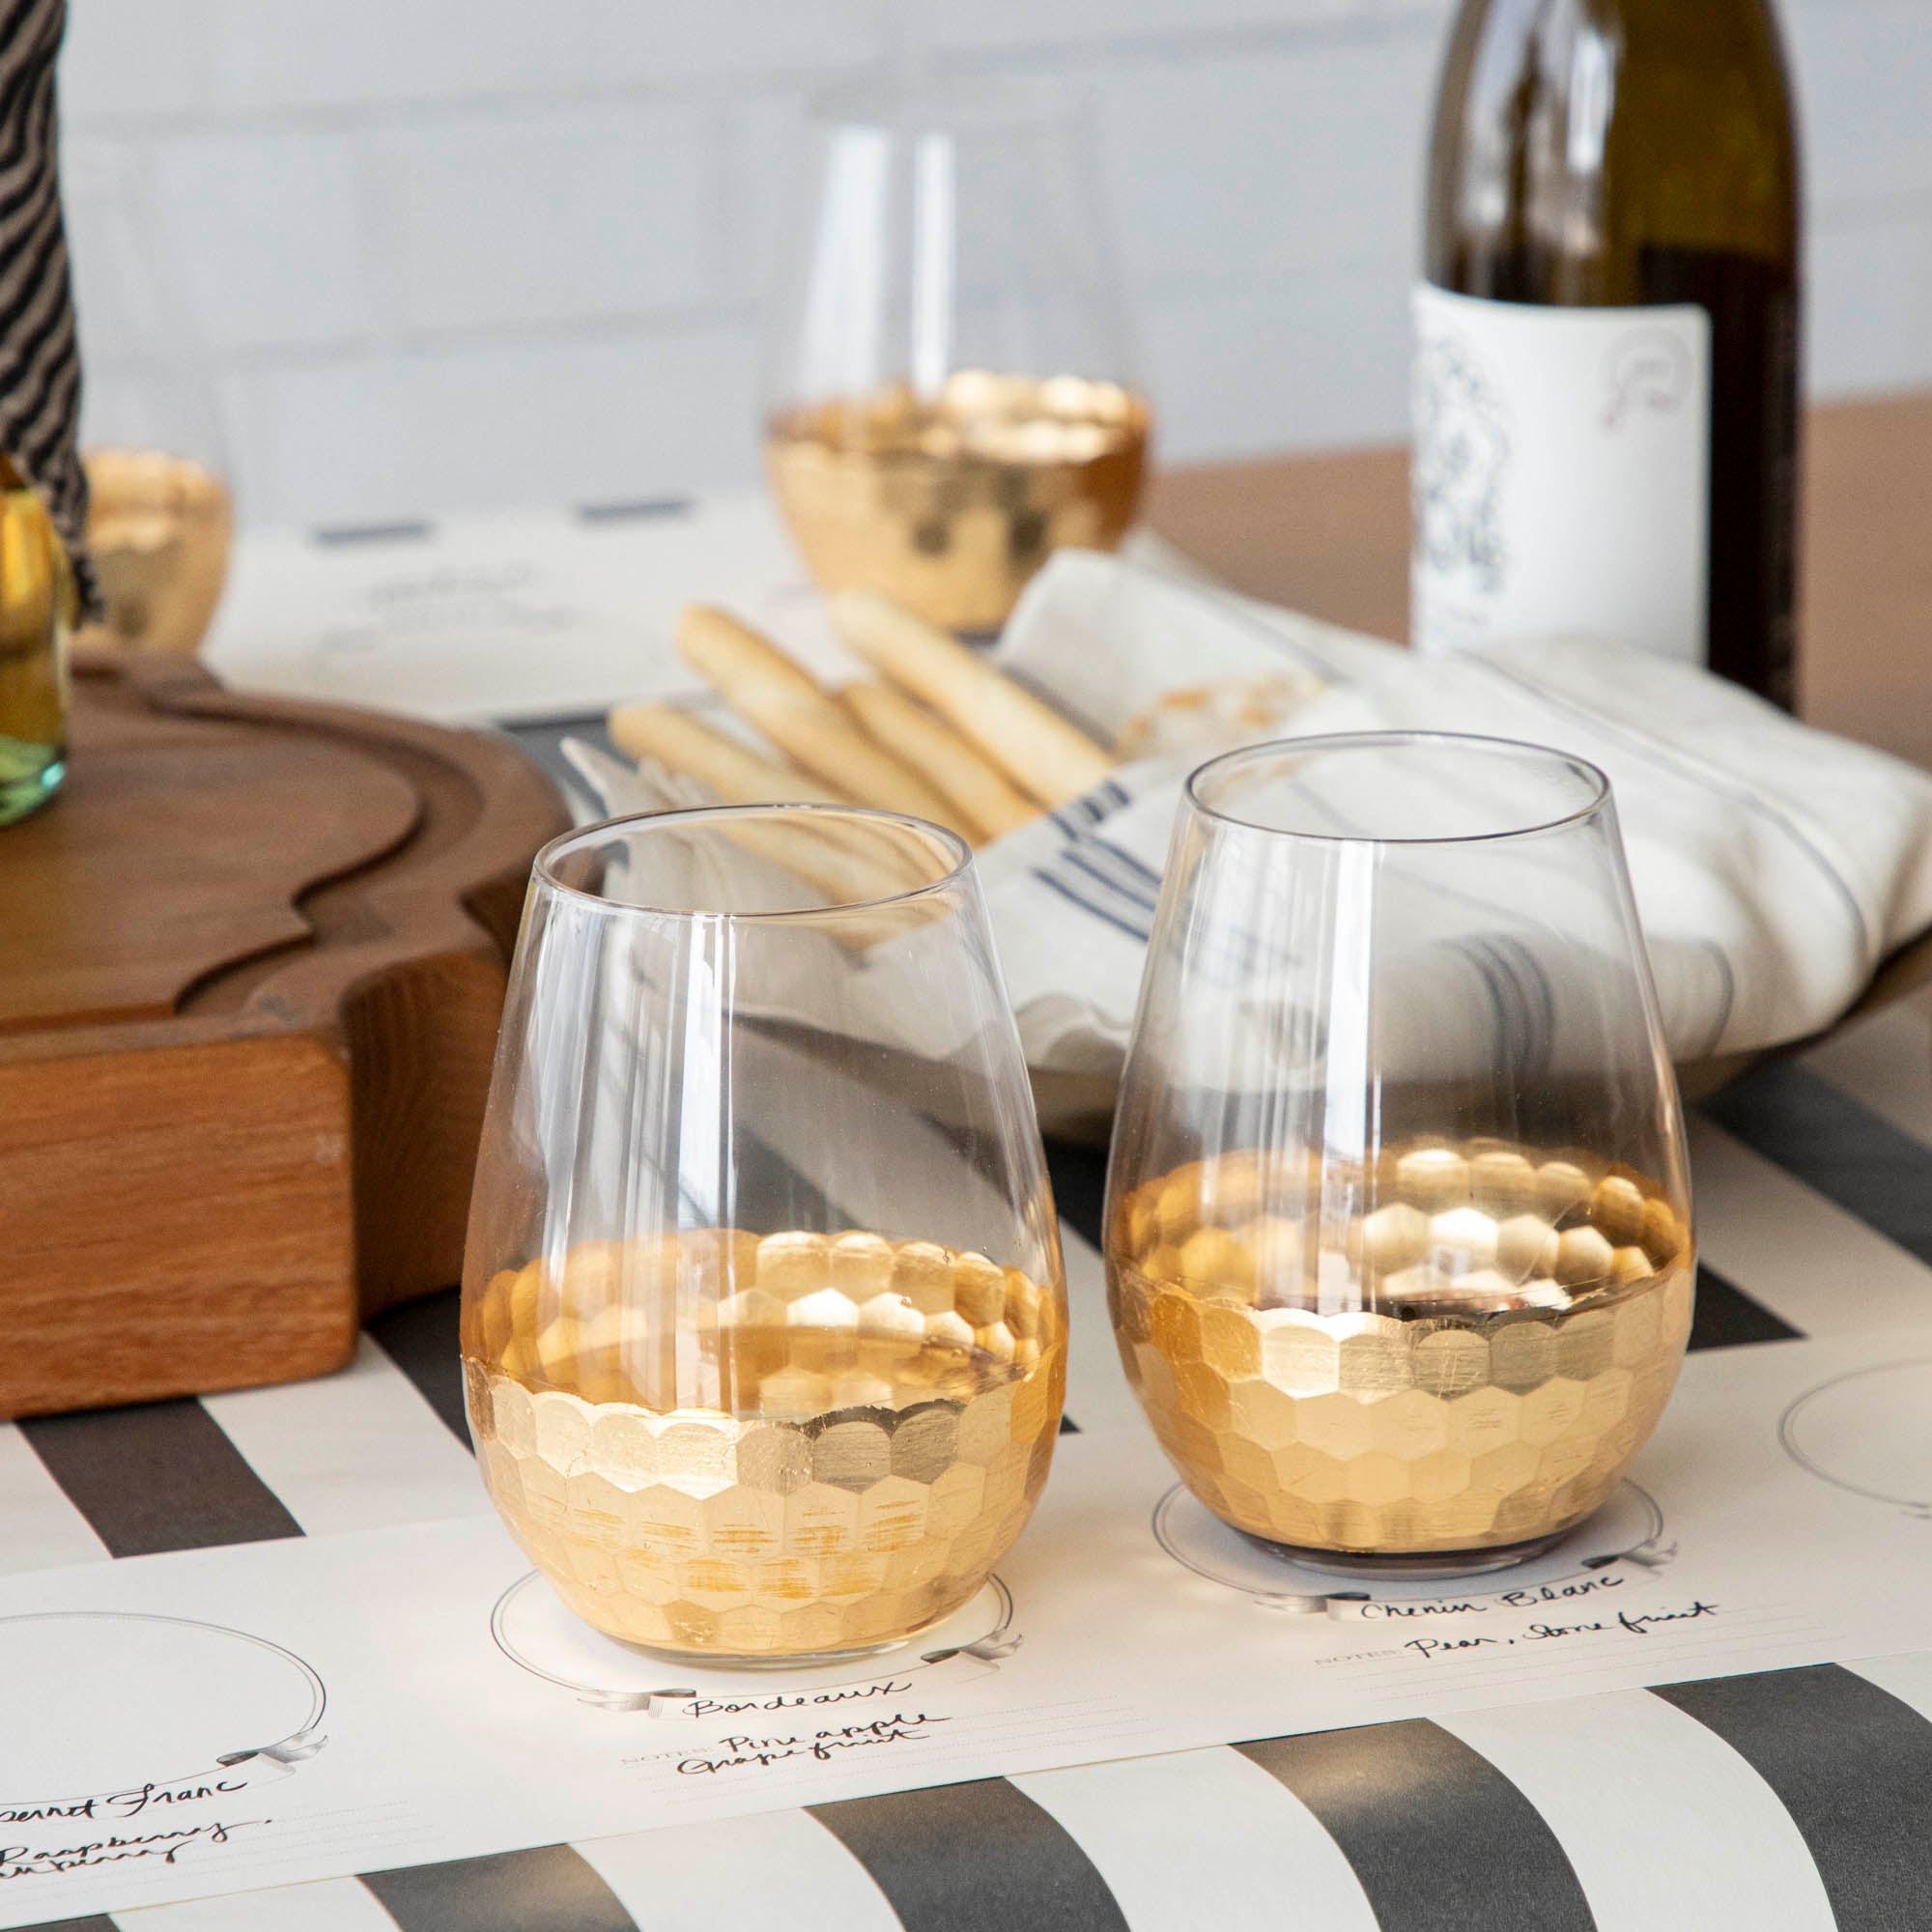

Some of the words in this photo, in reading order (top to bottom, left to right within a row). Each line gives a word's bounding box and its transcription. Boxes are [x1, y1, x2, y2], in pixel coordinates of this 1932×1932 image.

[1361, 1600, 1488, 1620] Chenin
[1500, 1575, 1625, 1608] Blanc
[1617, 1601, 1719, 1634] fruit
[682, 1681, 913, 1718] Bordeaux
[105, 1781, 248, 1818] Franc
